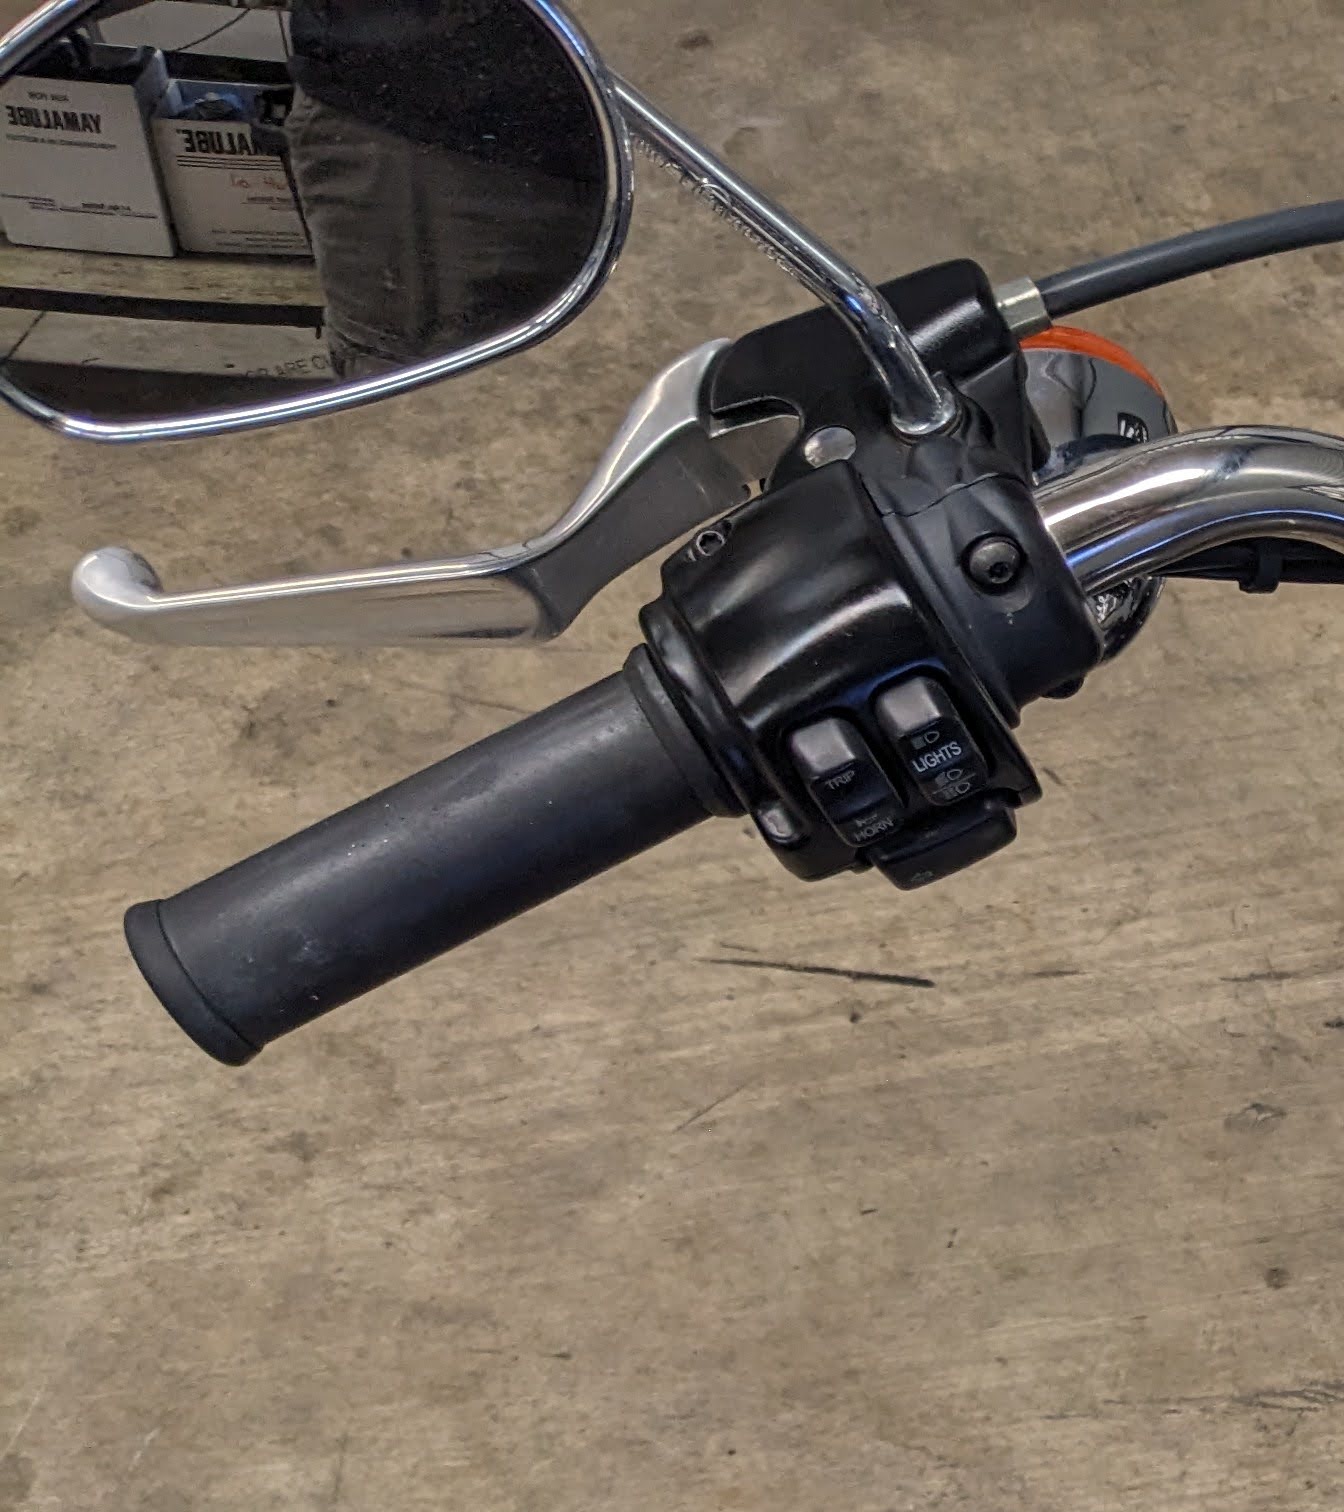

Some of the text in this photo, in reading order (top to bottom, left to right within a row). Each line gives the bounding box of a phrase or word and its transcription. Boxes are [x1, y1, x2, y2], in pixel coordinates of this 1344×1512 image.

[911, 740, 963, 774] LIGHTS
[824, 769, 856, 791] TRIP
[854, 817, 895, 842] HORN
